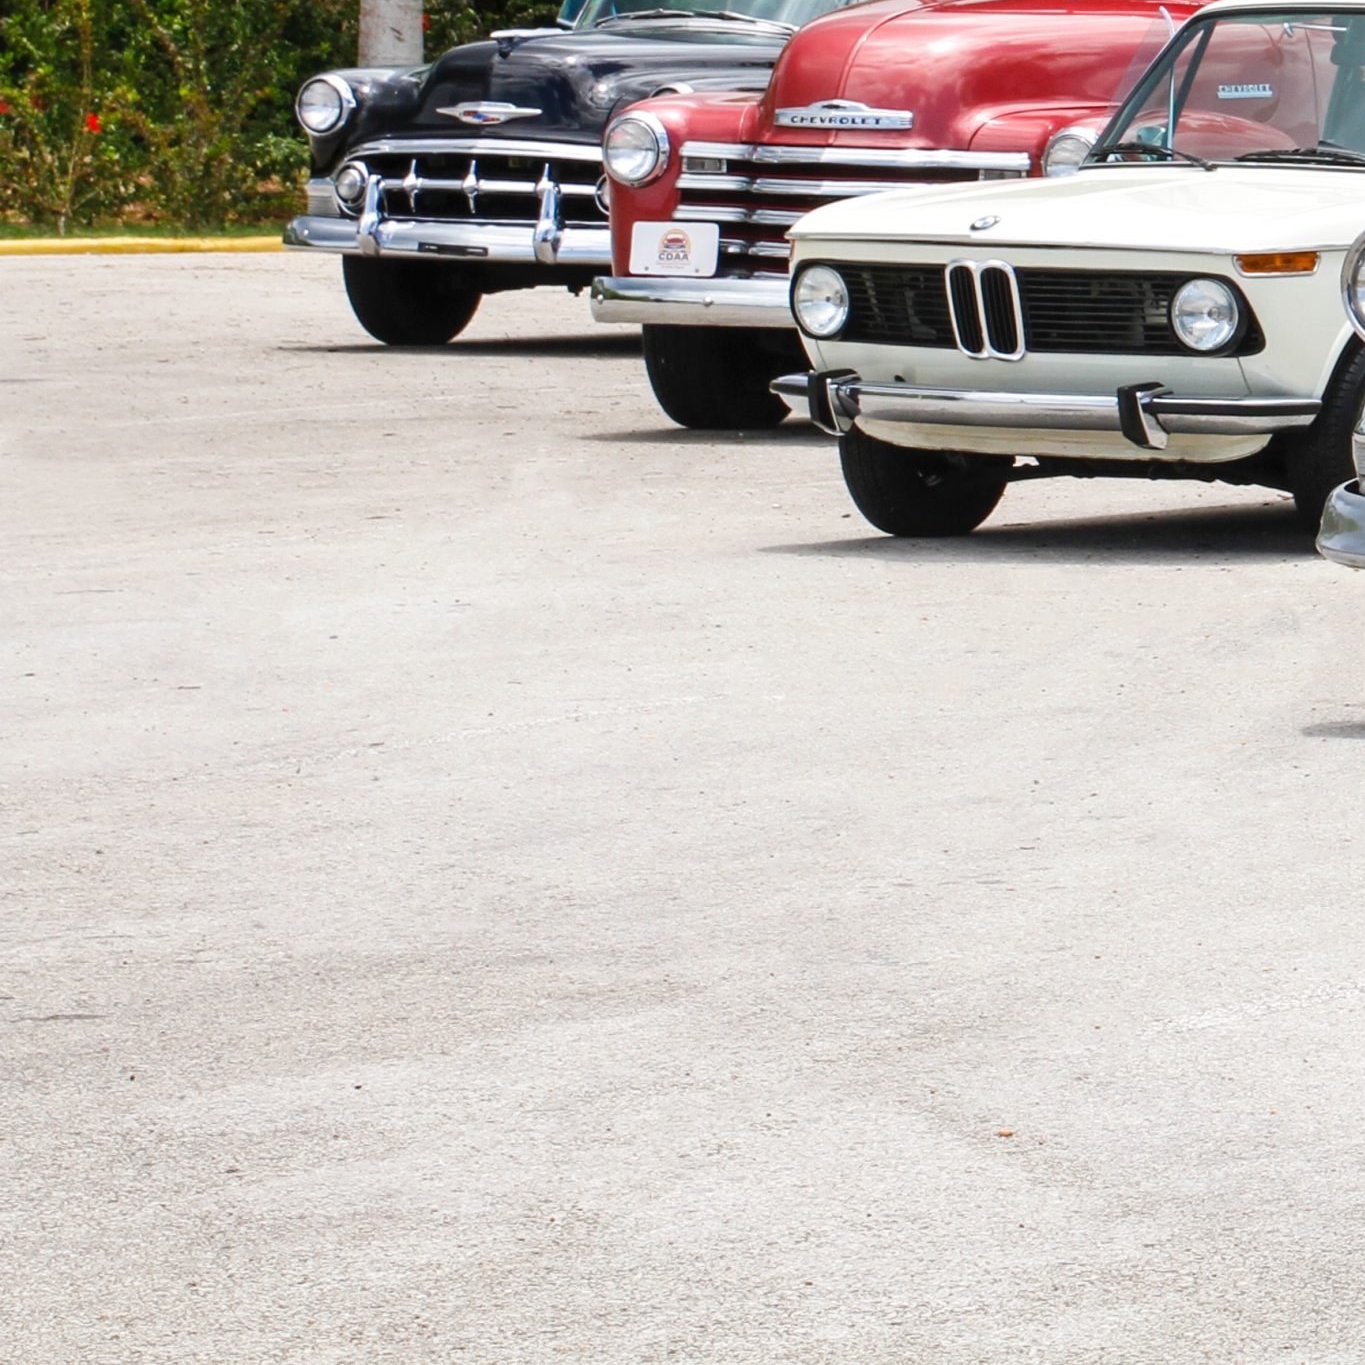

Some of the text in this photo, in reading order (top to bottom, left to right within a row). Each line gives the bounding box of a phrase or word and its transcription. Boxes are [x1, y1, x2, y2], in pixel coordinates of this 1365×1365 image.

[1218, 82, 1271, 93] CHEVROLET
[790, 115, 883, 126] CHEVROLET
[658, 252, 689, 261] CDAA
